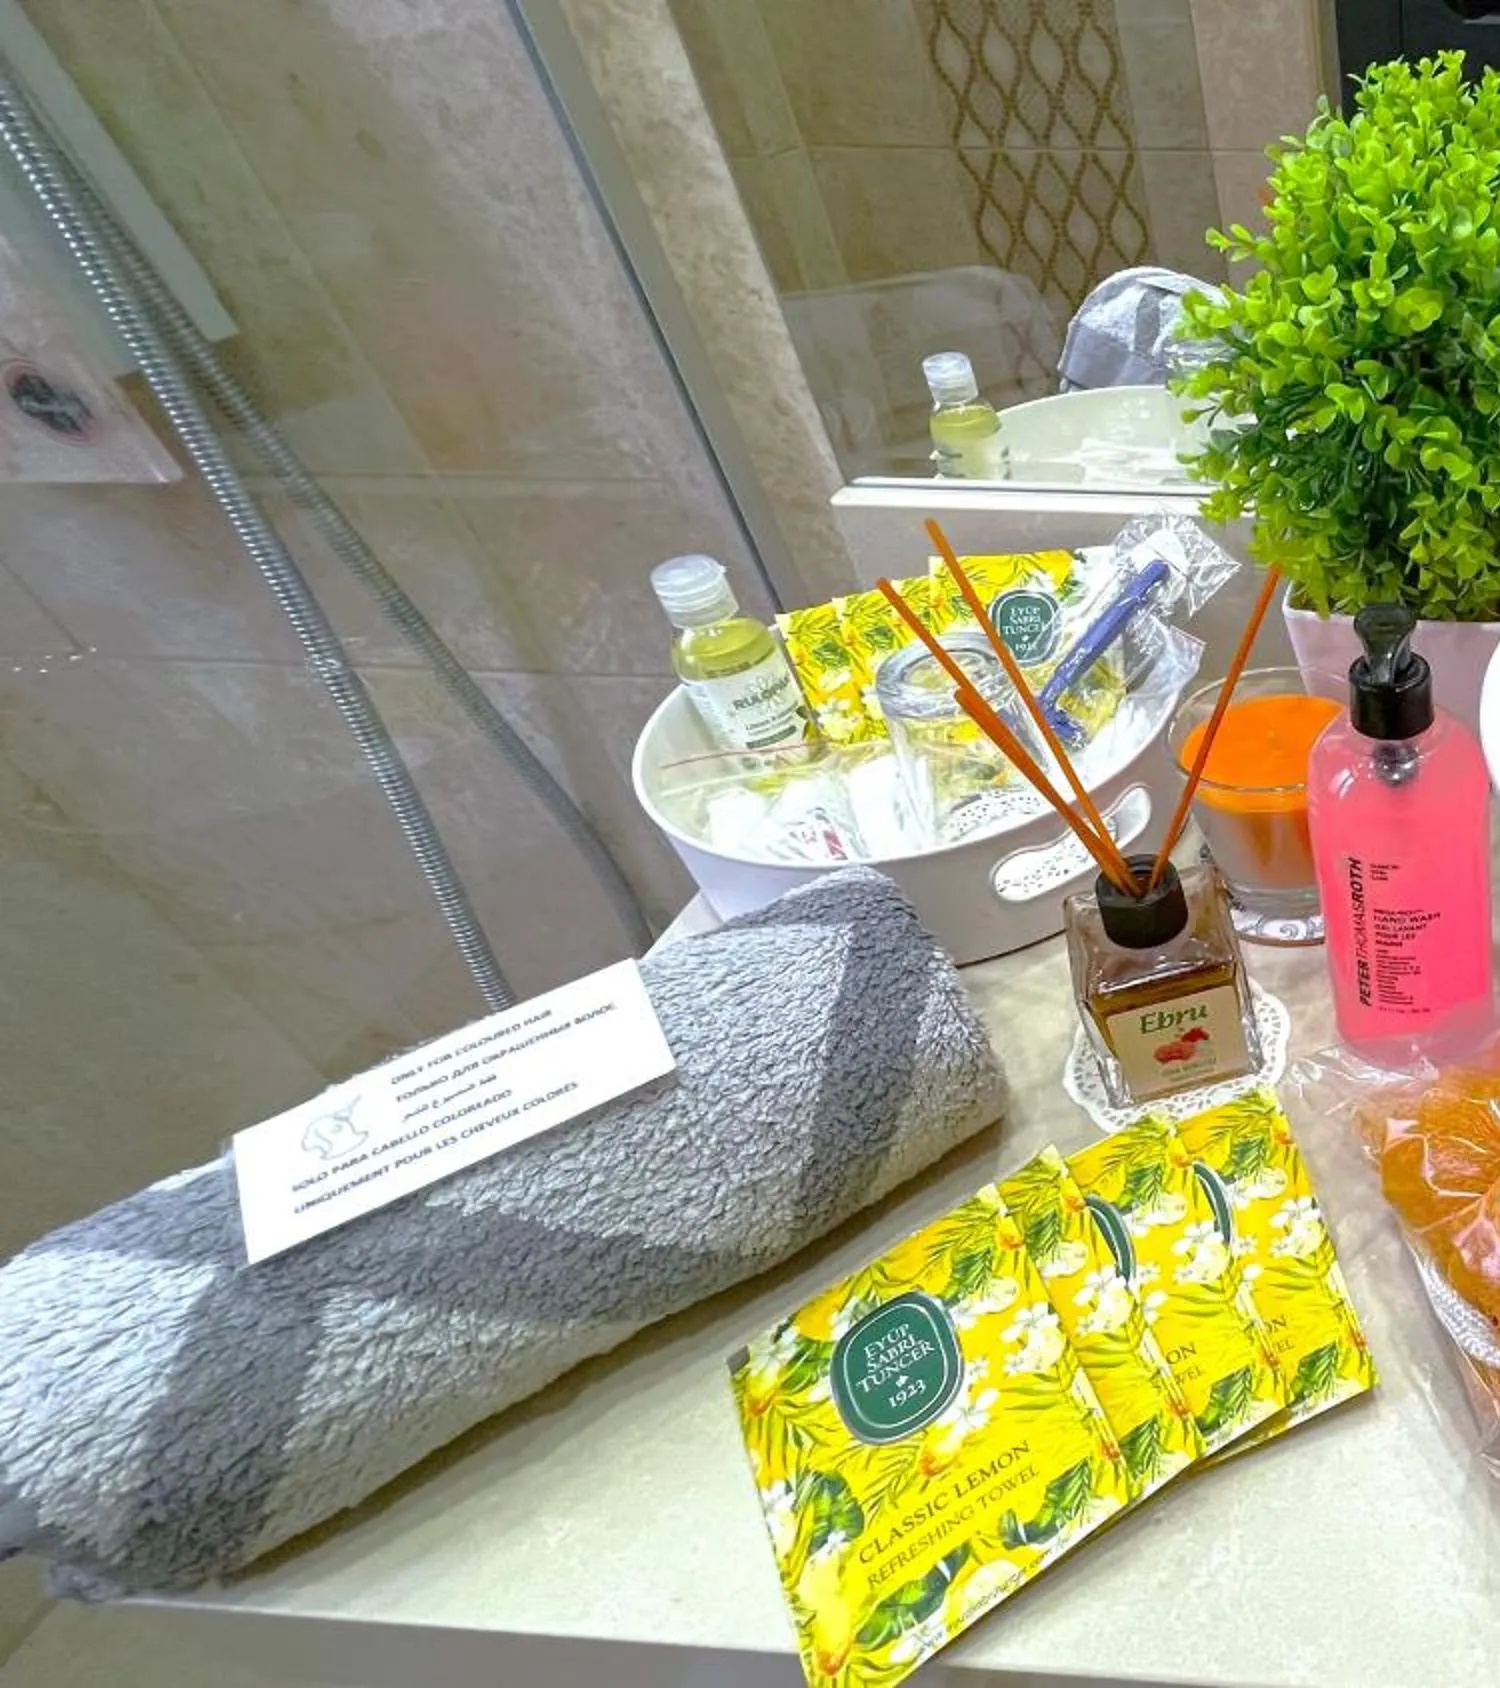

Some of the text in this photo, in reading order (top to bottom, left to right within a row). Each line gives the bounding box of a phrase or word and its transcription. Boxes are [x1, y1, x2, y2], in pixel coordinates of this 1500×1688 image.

[1140, 1004, 1209, 1035] Ebru
[427, 1052, 453, 1069] FOR
[292, 1170, 330, 1193] SOLO
[331, 1152, 369, 1175] PARA
[371, 1124, 430, 1156] CABELLO
[394, 1146, 433, 1169] POUR
[435, 1134, 459, 1151] LES
[459, 1107, 521, 1140] CHEVEUX
[855, 1339, 936, 1393] TUNCER
[888, 1379, 927, 1408] 1923
[857, 1438, 1032, 1566] CLASSIC LEMON
[865, 1464, 1042, 1591] REFRESHING TOWEL
